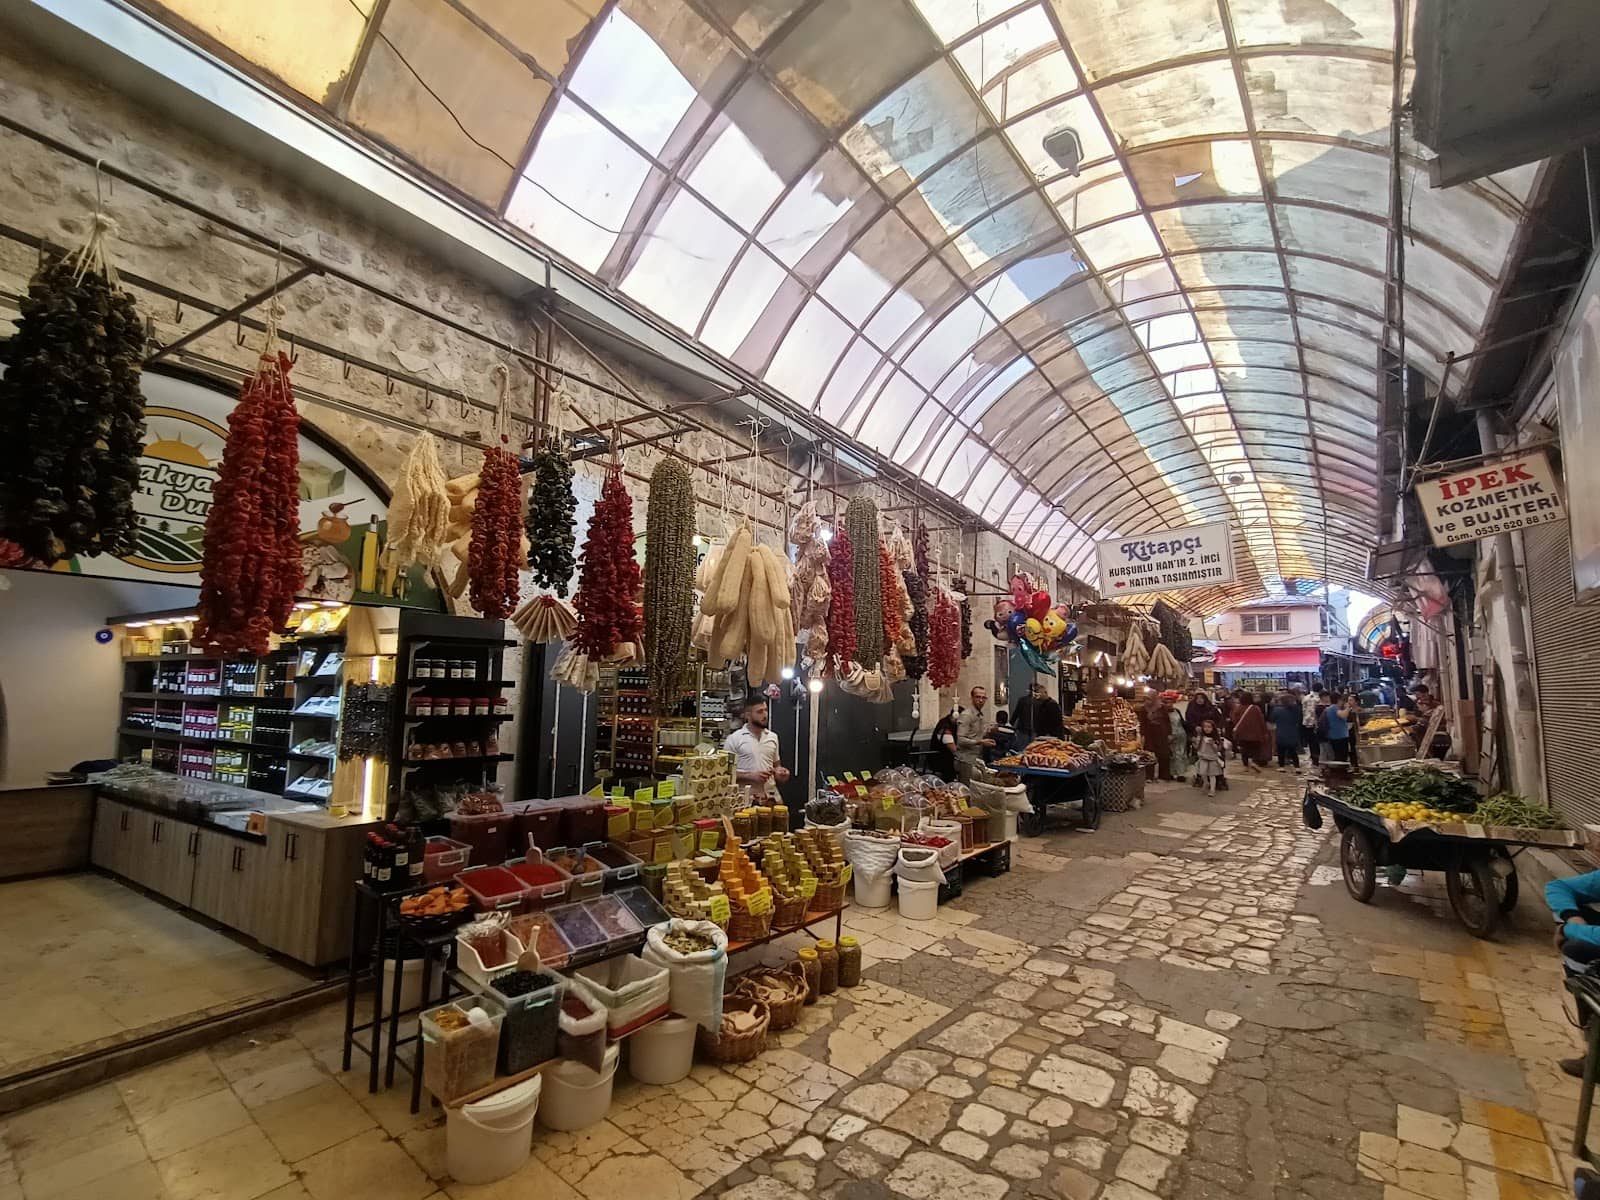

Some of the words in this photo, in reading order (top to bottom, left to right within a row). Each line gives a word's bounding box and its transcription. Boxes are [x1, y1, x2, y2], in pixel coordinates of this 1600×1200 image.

[1438, 463, 1534, 500] İPEK
[160, 490, 209, 516] Du
[1434, 521, 1456, 534] ve
[1463, 492, 1560, 528] BUJİTERİ
[1436, 482, 1544, 517] KOZMETİK
[1447, 532, 1473, 543] Gsm.
[1475, 525, 1501, 536] 0535
[1503, 519, 1523, 530] 620
[1526, 515, 1540, 525] 88
[1544, 511, 1557, 521] 13
[1120, 536, 1203, 562] Kitapçı
[1108, 563, 1153, 578] KURŞUNLU
[1189, 557, 1198, 567] 2.
[1129, 574, 1160, 588] KATINA
